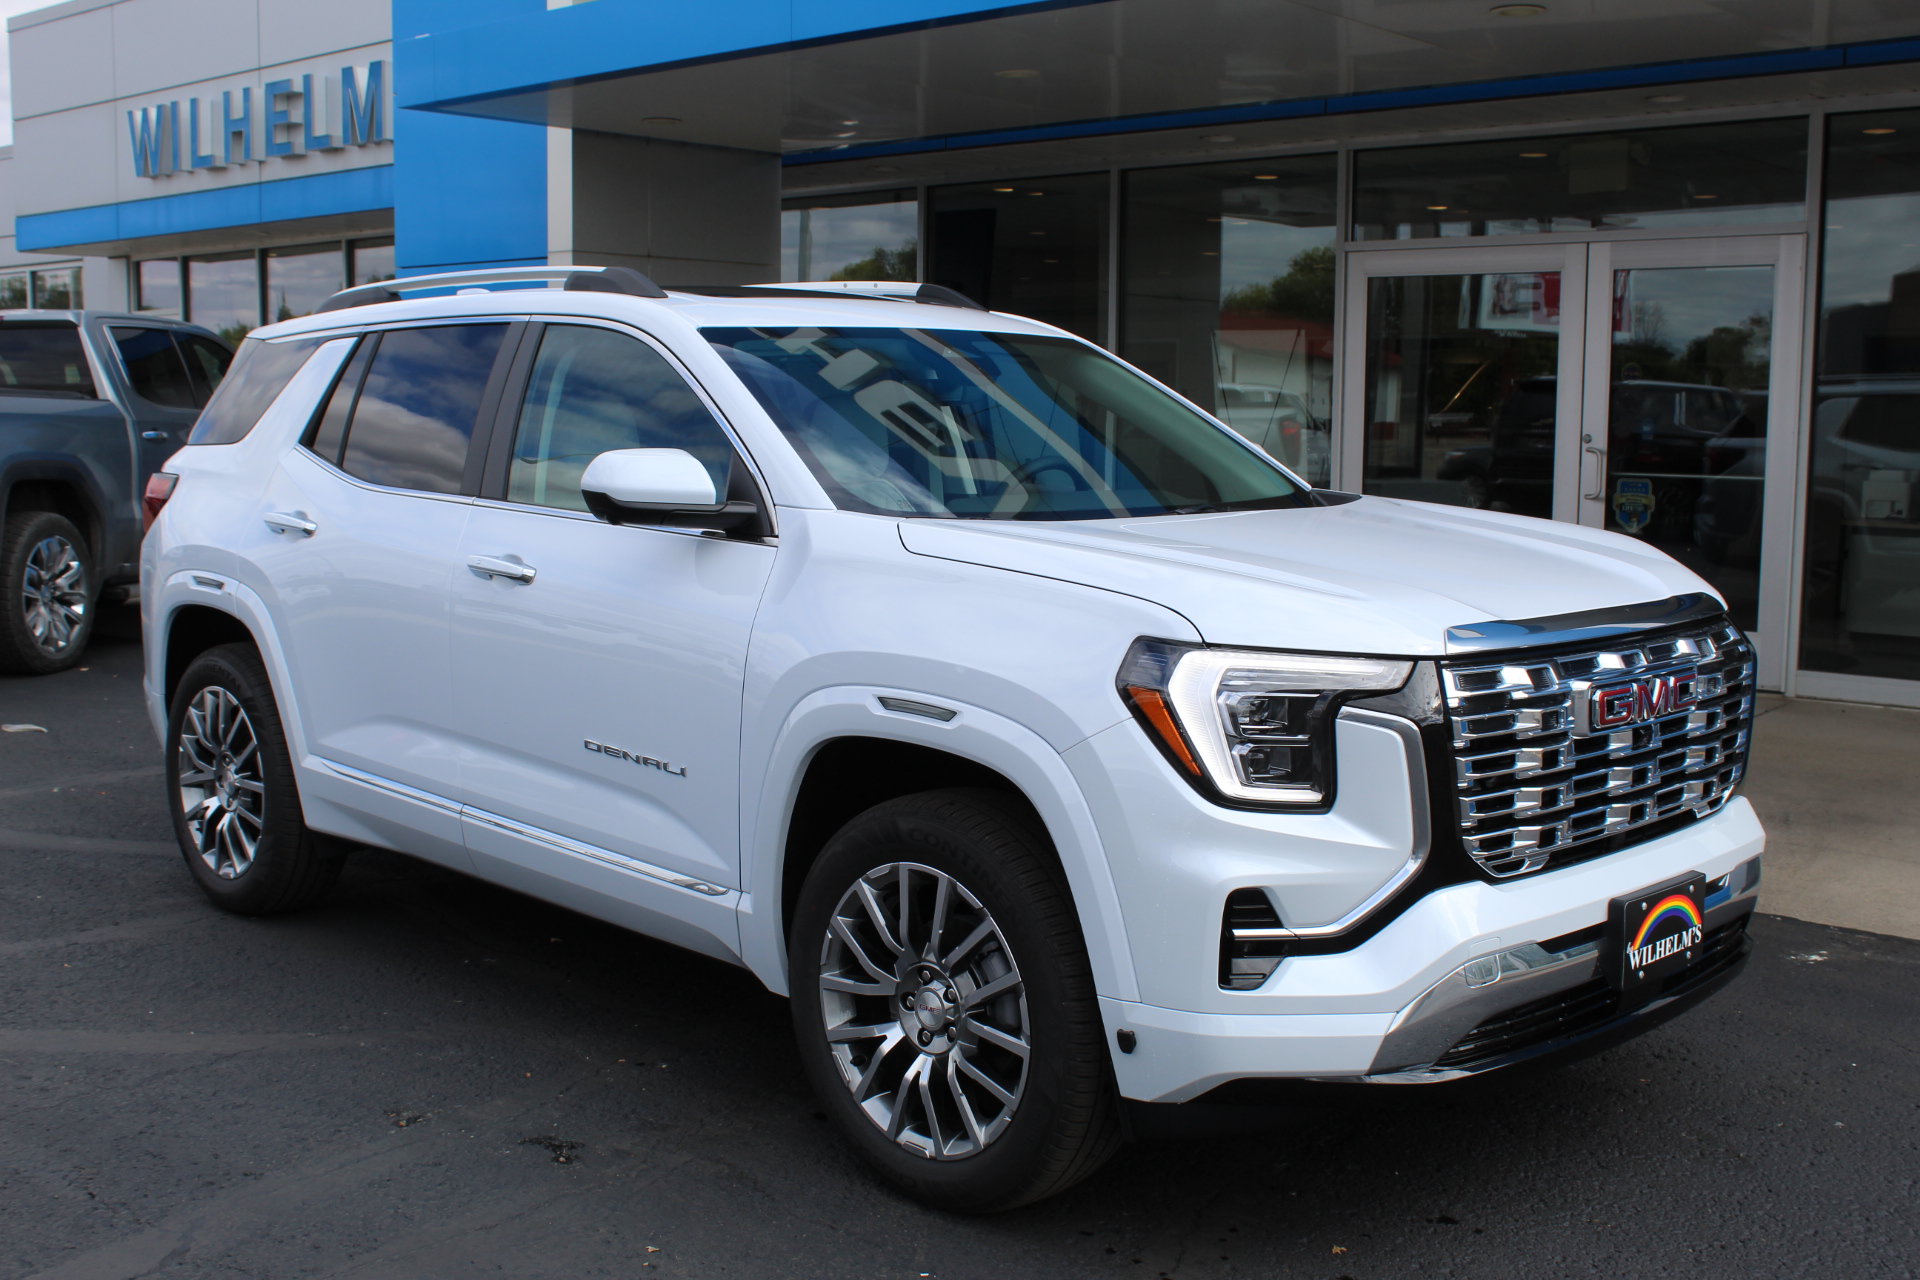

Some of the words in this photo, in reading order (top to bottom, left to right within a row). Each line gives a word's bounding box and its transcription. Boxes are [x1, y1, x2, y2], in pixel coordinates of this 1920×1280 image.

[128, 60, 387, 178] WILHELM
[1596, 673, 1697, 727] GMC
[583, 738, 688, 778] DENALI
[1628, 923, 1702, 971] WILHELM'S
